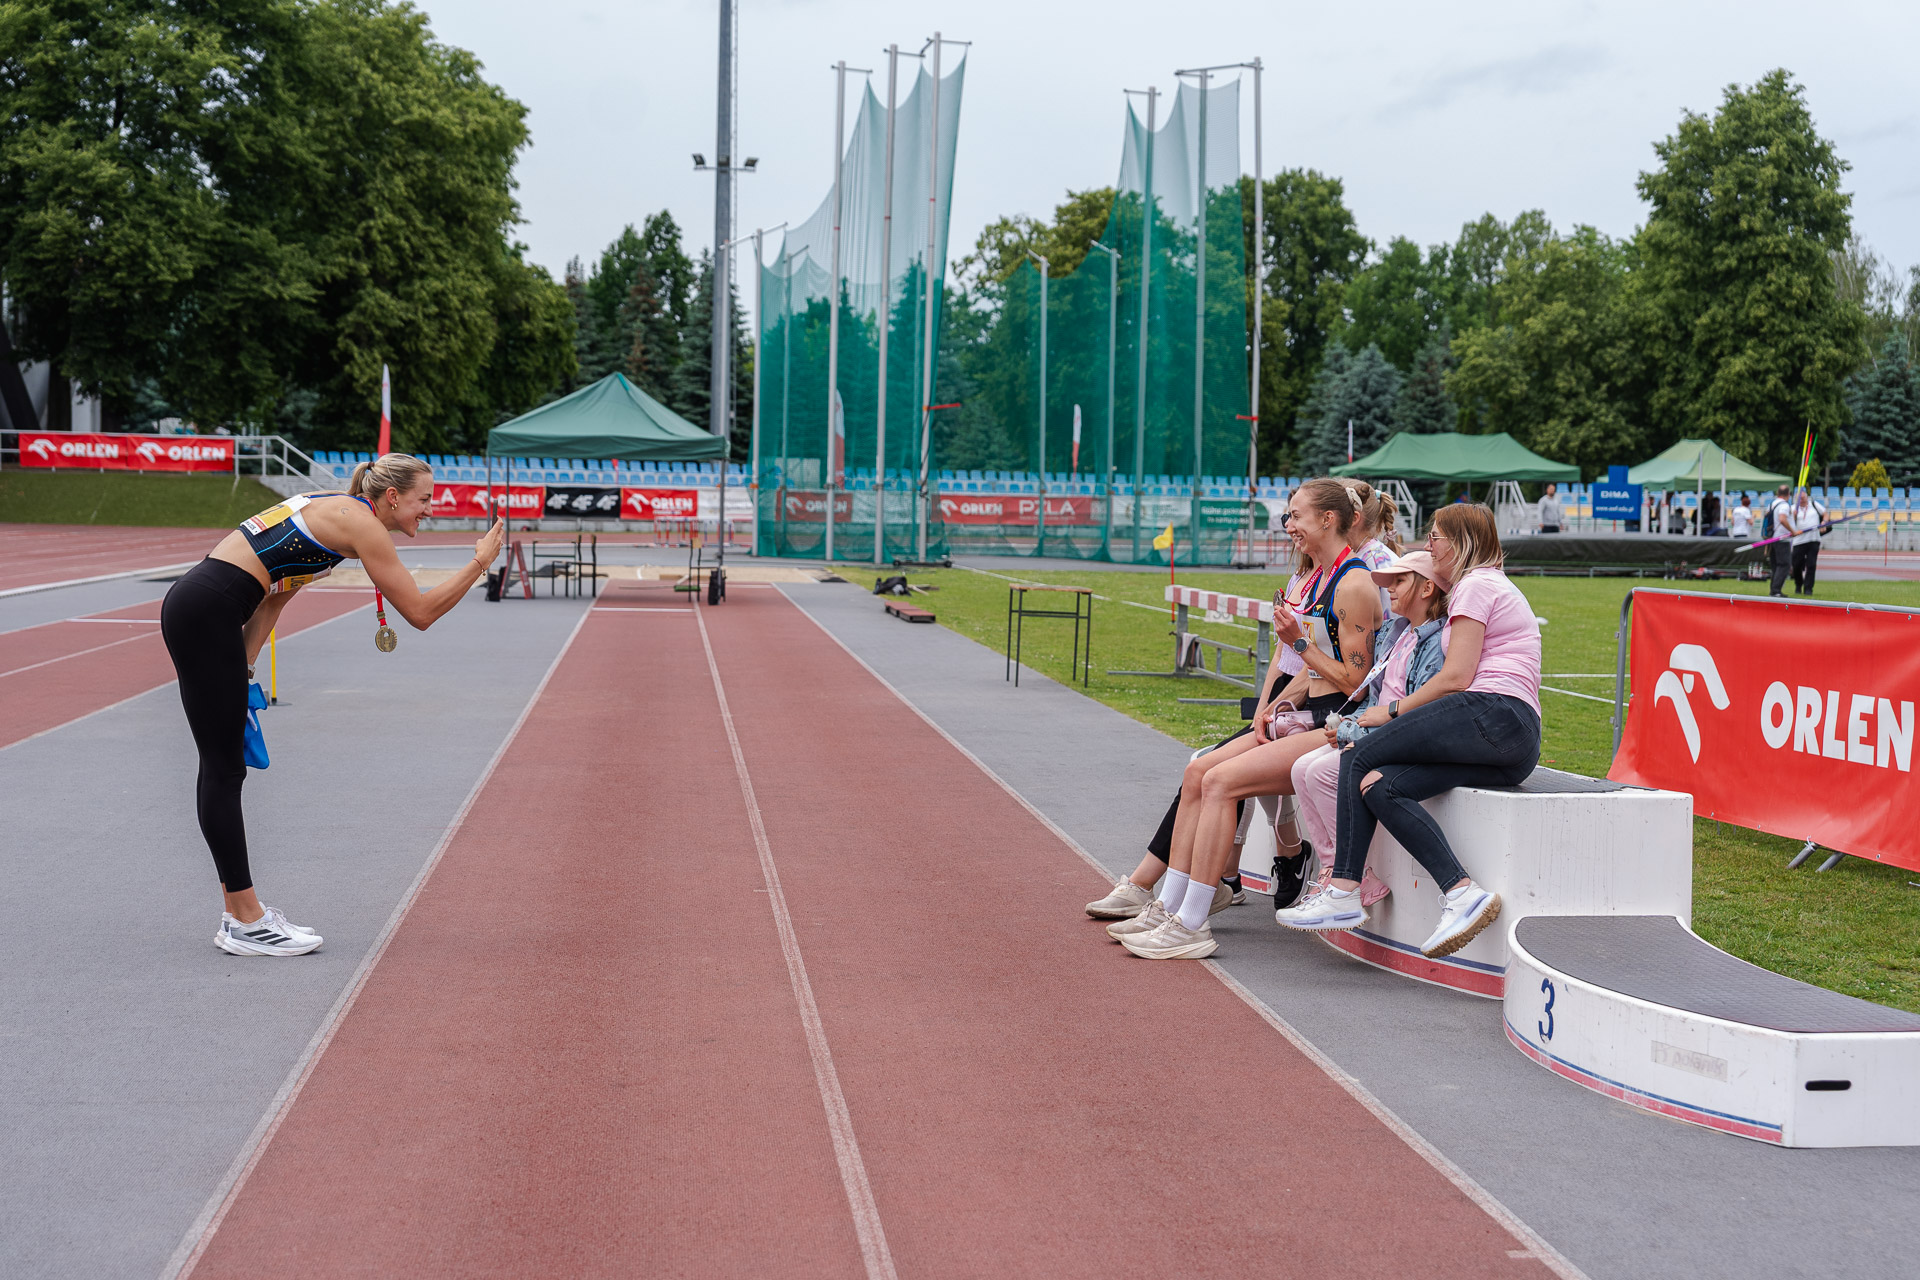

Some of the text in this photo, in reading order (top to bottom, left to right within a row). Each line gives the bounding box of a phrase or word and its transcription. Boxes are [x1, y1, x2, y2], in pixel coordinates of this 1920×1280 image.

[61, 442, 119, 458] ORLEN
[168, 445, 226, 461] ORLEN
[498, 494, 539, 508] ORLEN
[546, 493, 619, 510] 4F 4F 4F
[1600, 490, 1630, 499] DIMA
[651, 497, 693, 511] ORLEN
[805, 500, 847, 513] OREN
[960, 502, 1003, 515] ORLEN
[1760, 680, 1915, 773] ORLEN
[1538, 977, 1555, 1043] 3
